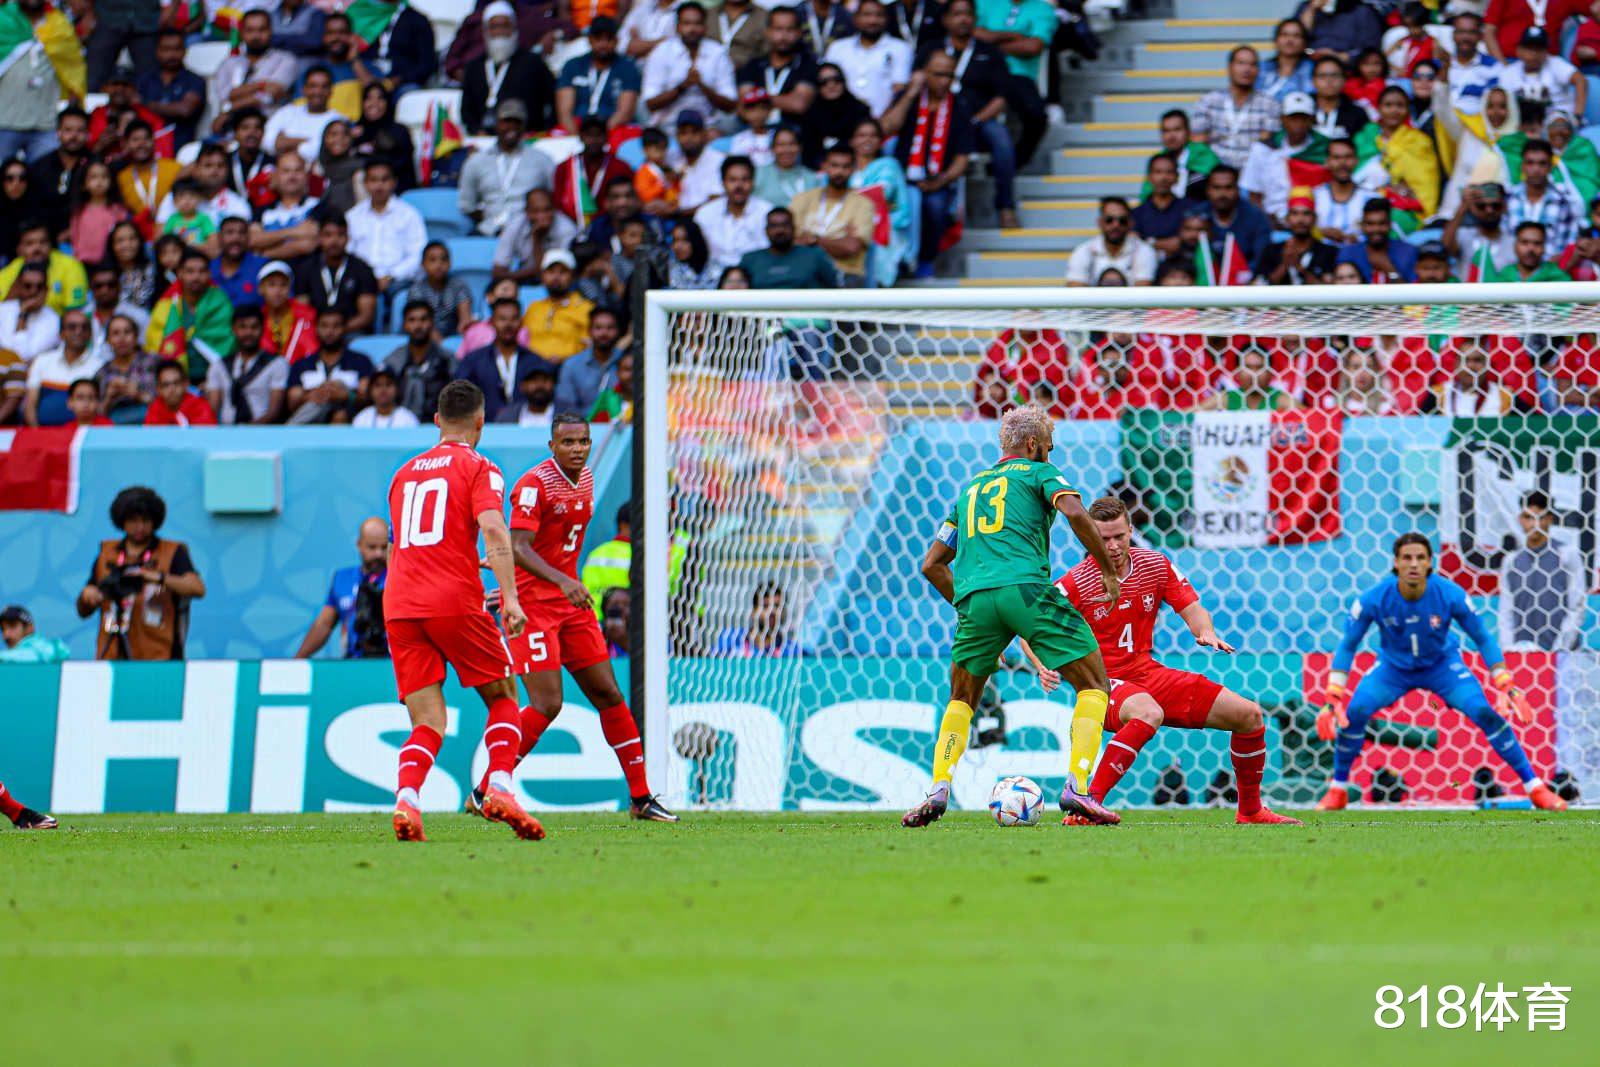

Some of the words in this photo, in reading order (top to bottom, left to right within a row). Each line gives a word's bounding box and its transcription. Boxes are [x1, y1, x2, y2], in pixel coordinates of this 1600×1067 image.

[412, 456, 452, 471] XHAKA
[400, 477, 448, 549] 10
[966, 476, 1008, 538] 13
[563, 524, 582, 552] 5
[528, 632, 548, 662] 5
[1118, 623, 1134, 653] 4
[1409, 632, 1419, 657] 1
[50, 659, 1107, 813] Hisense
